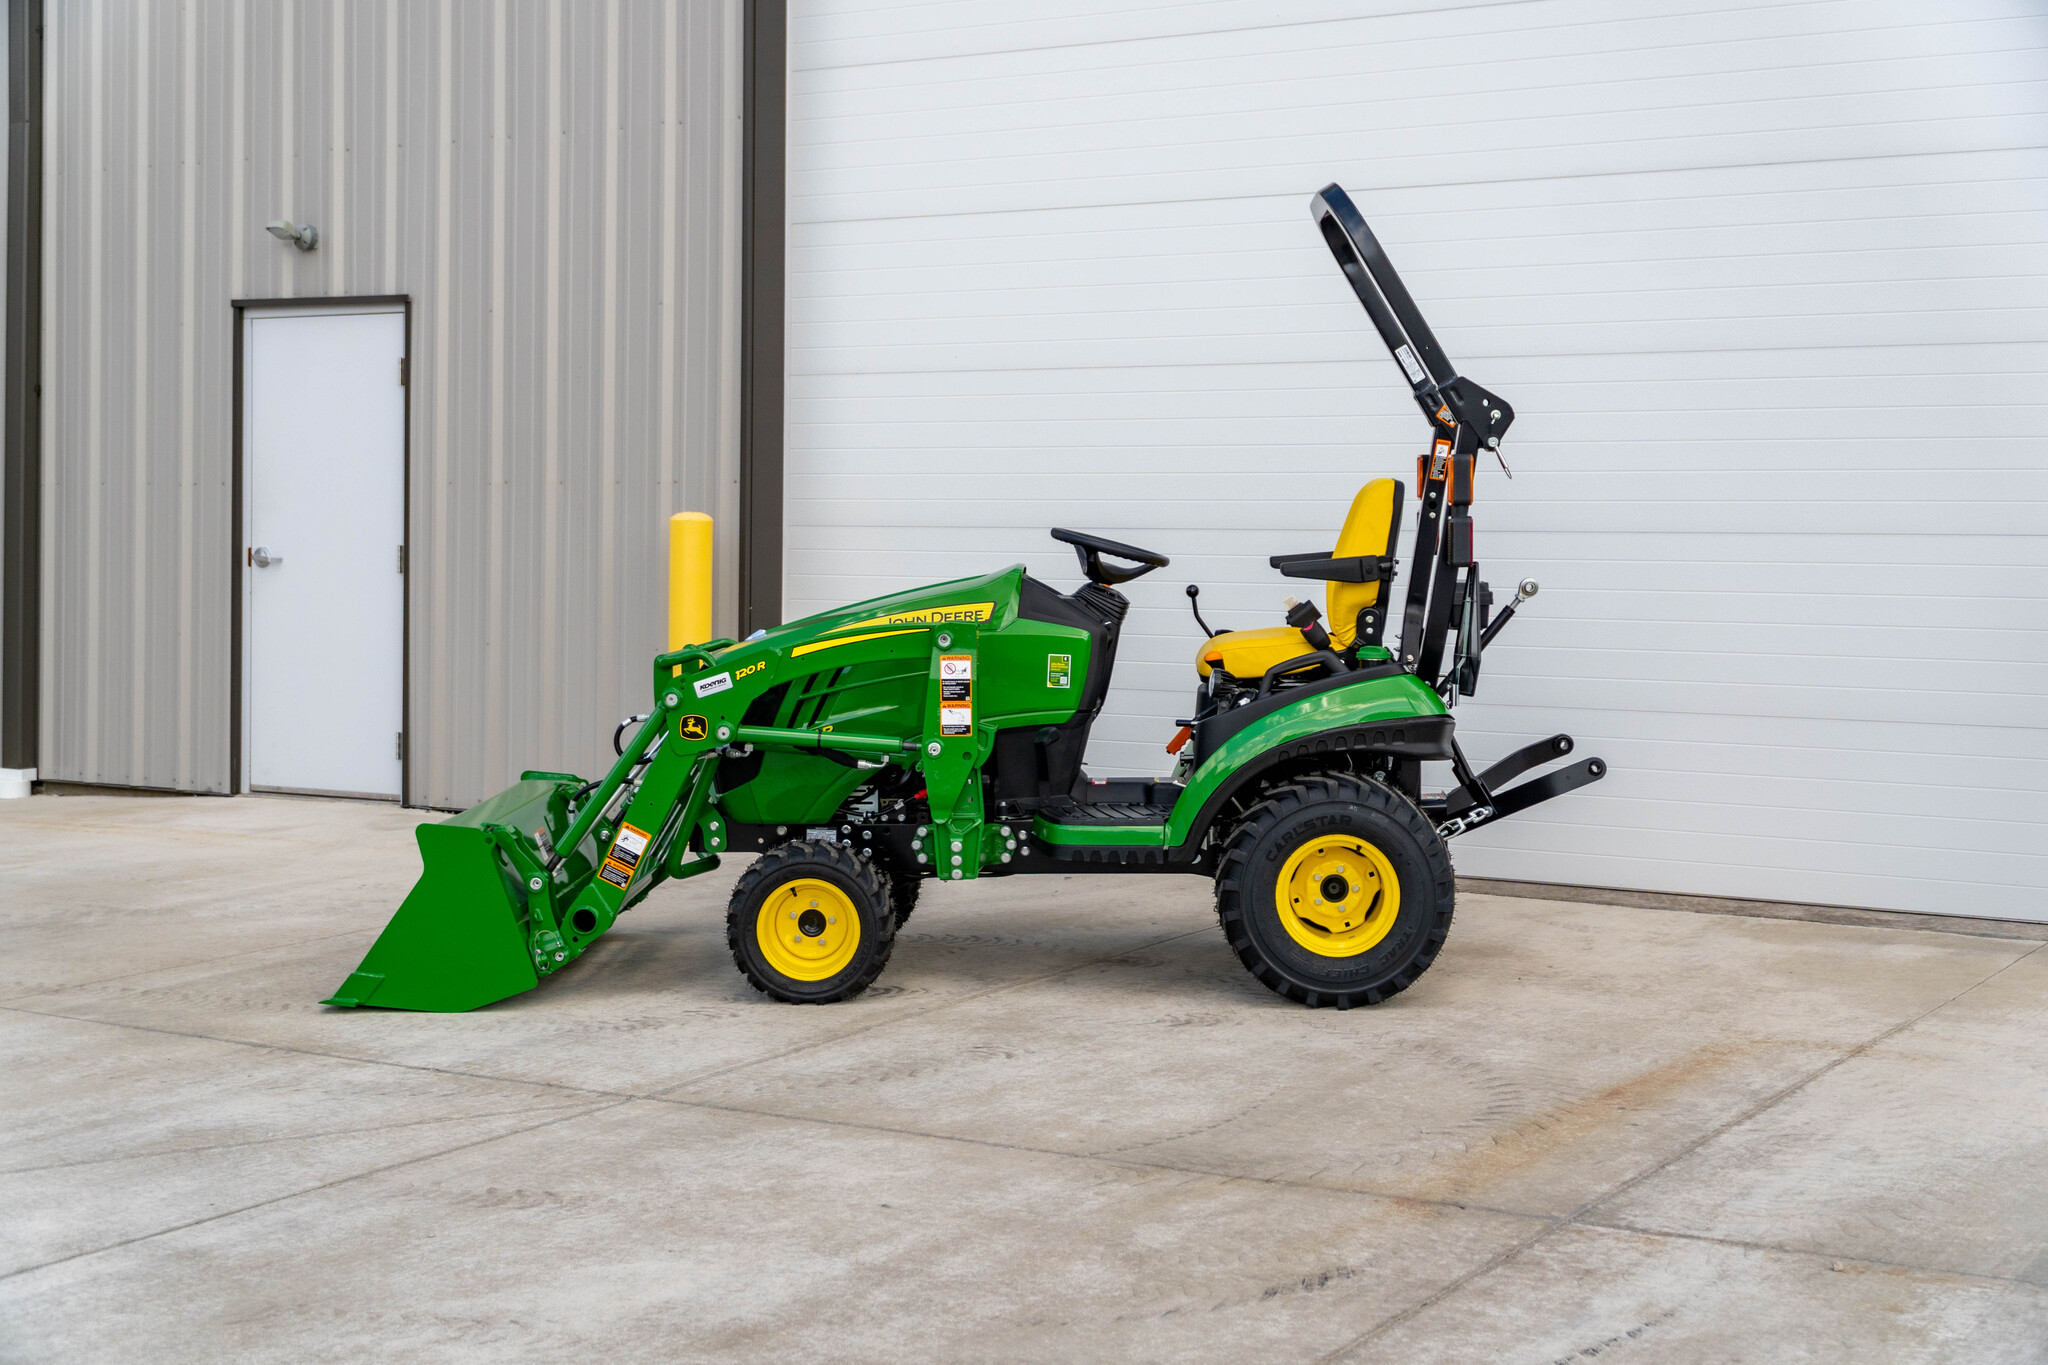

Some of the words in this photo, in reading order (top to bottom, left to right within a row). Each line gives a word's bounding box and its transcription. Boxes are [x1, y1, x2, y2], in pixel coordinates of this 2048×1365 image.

[931, 610, 984, 623] DEERE
[735, 665, 756, 680] 120
[757, 661, 766, 671] R
